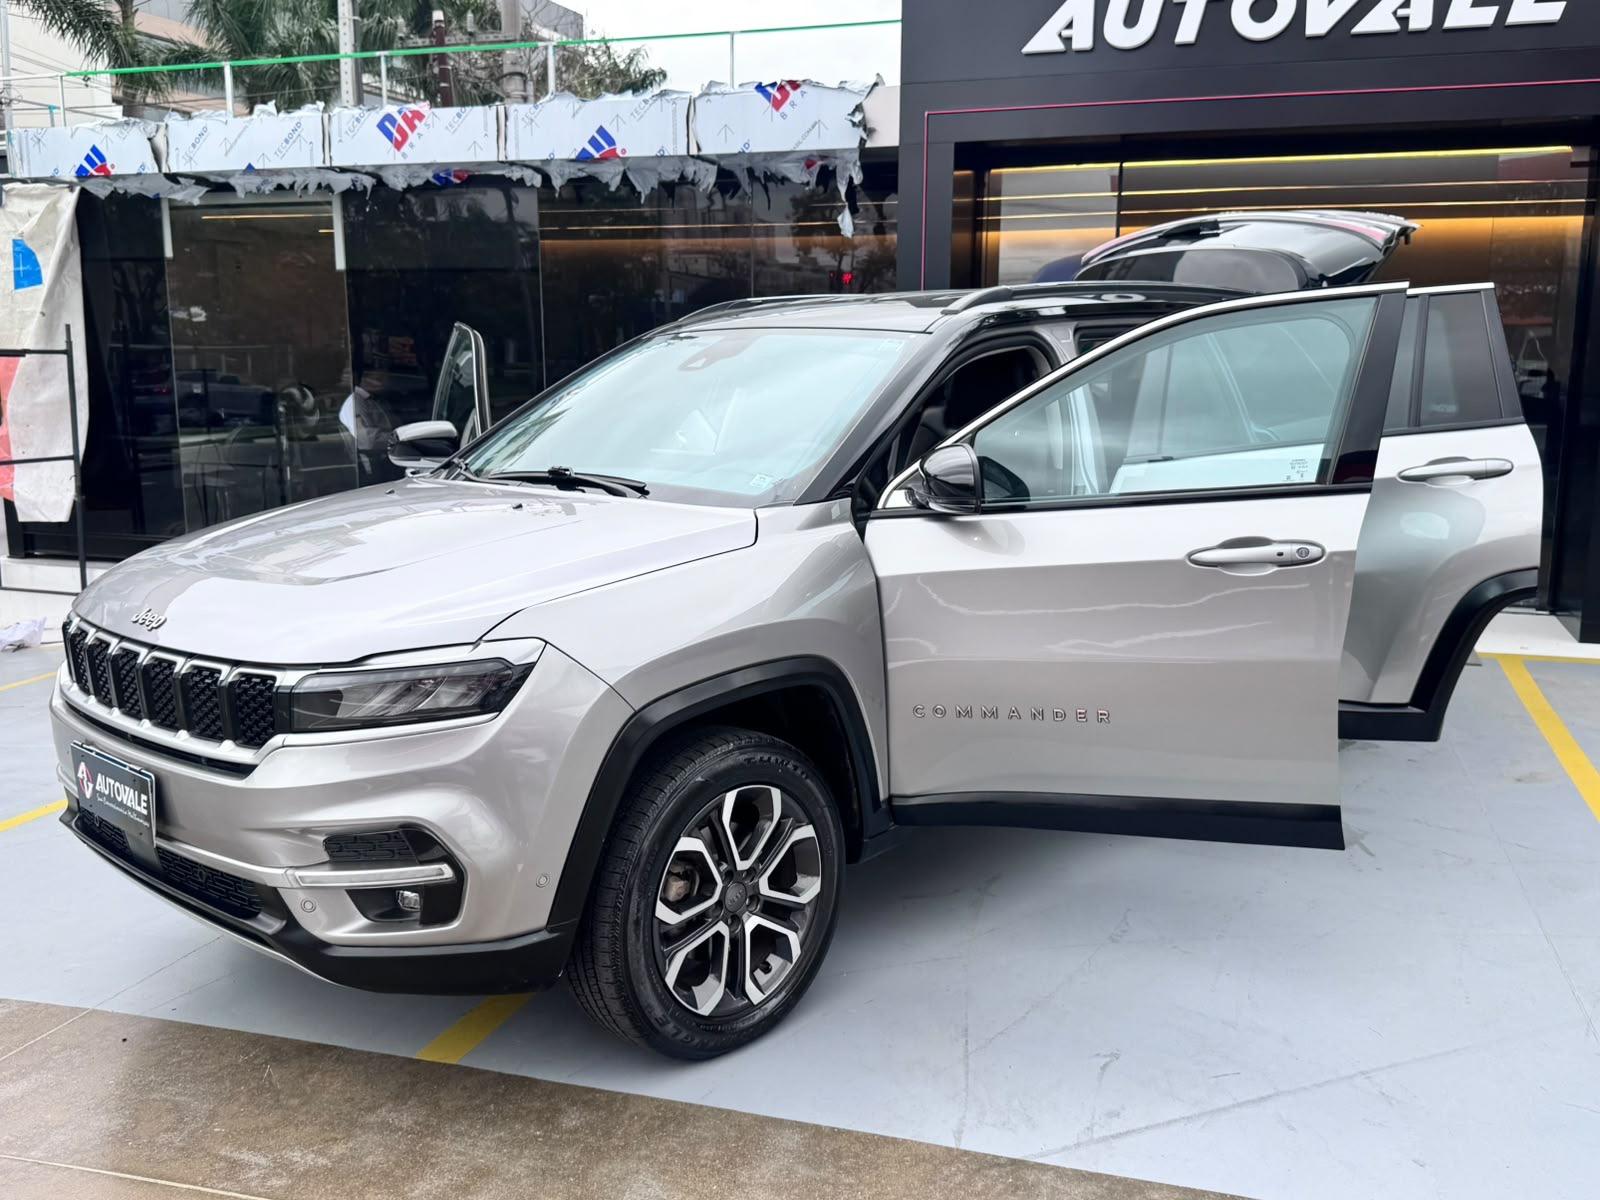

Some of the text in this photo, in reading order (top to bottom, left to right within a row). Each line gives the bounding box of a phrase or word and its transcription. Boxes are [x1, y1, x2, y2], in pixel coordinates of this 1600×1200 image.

[274, 121, 302, 157] TECBOND
[131, 608, 167, 631] Jeep
[912, 704, 1111, 724] COMMANDER
[95, 773, 148, 816] AUTOVALE
